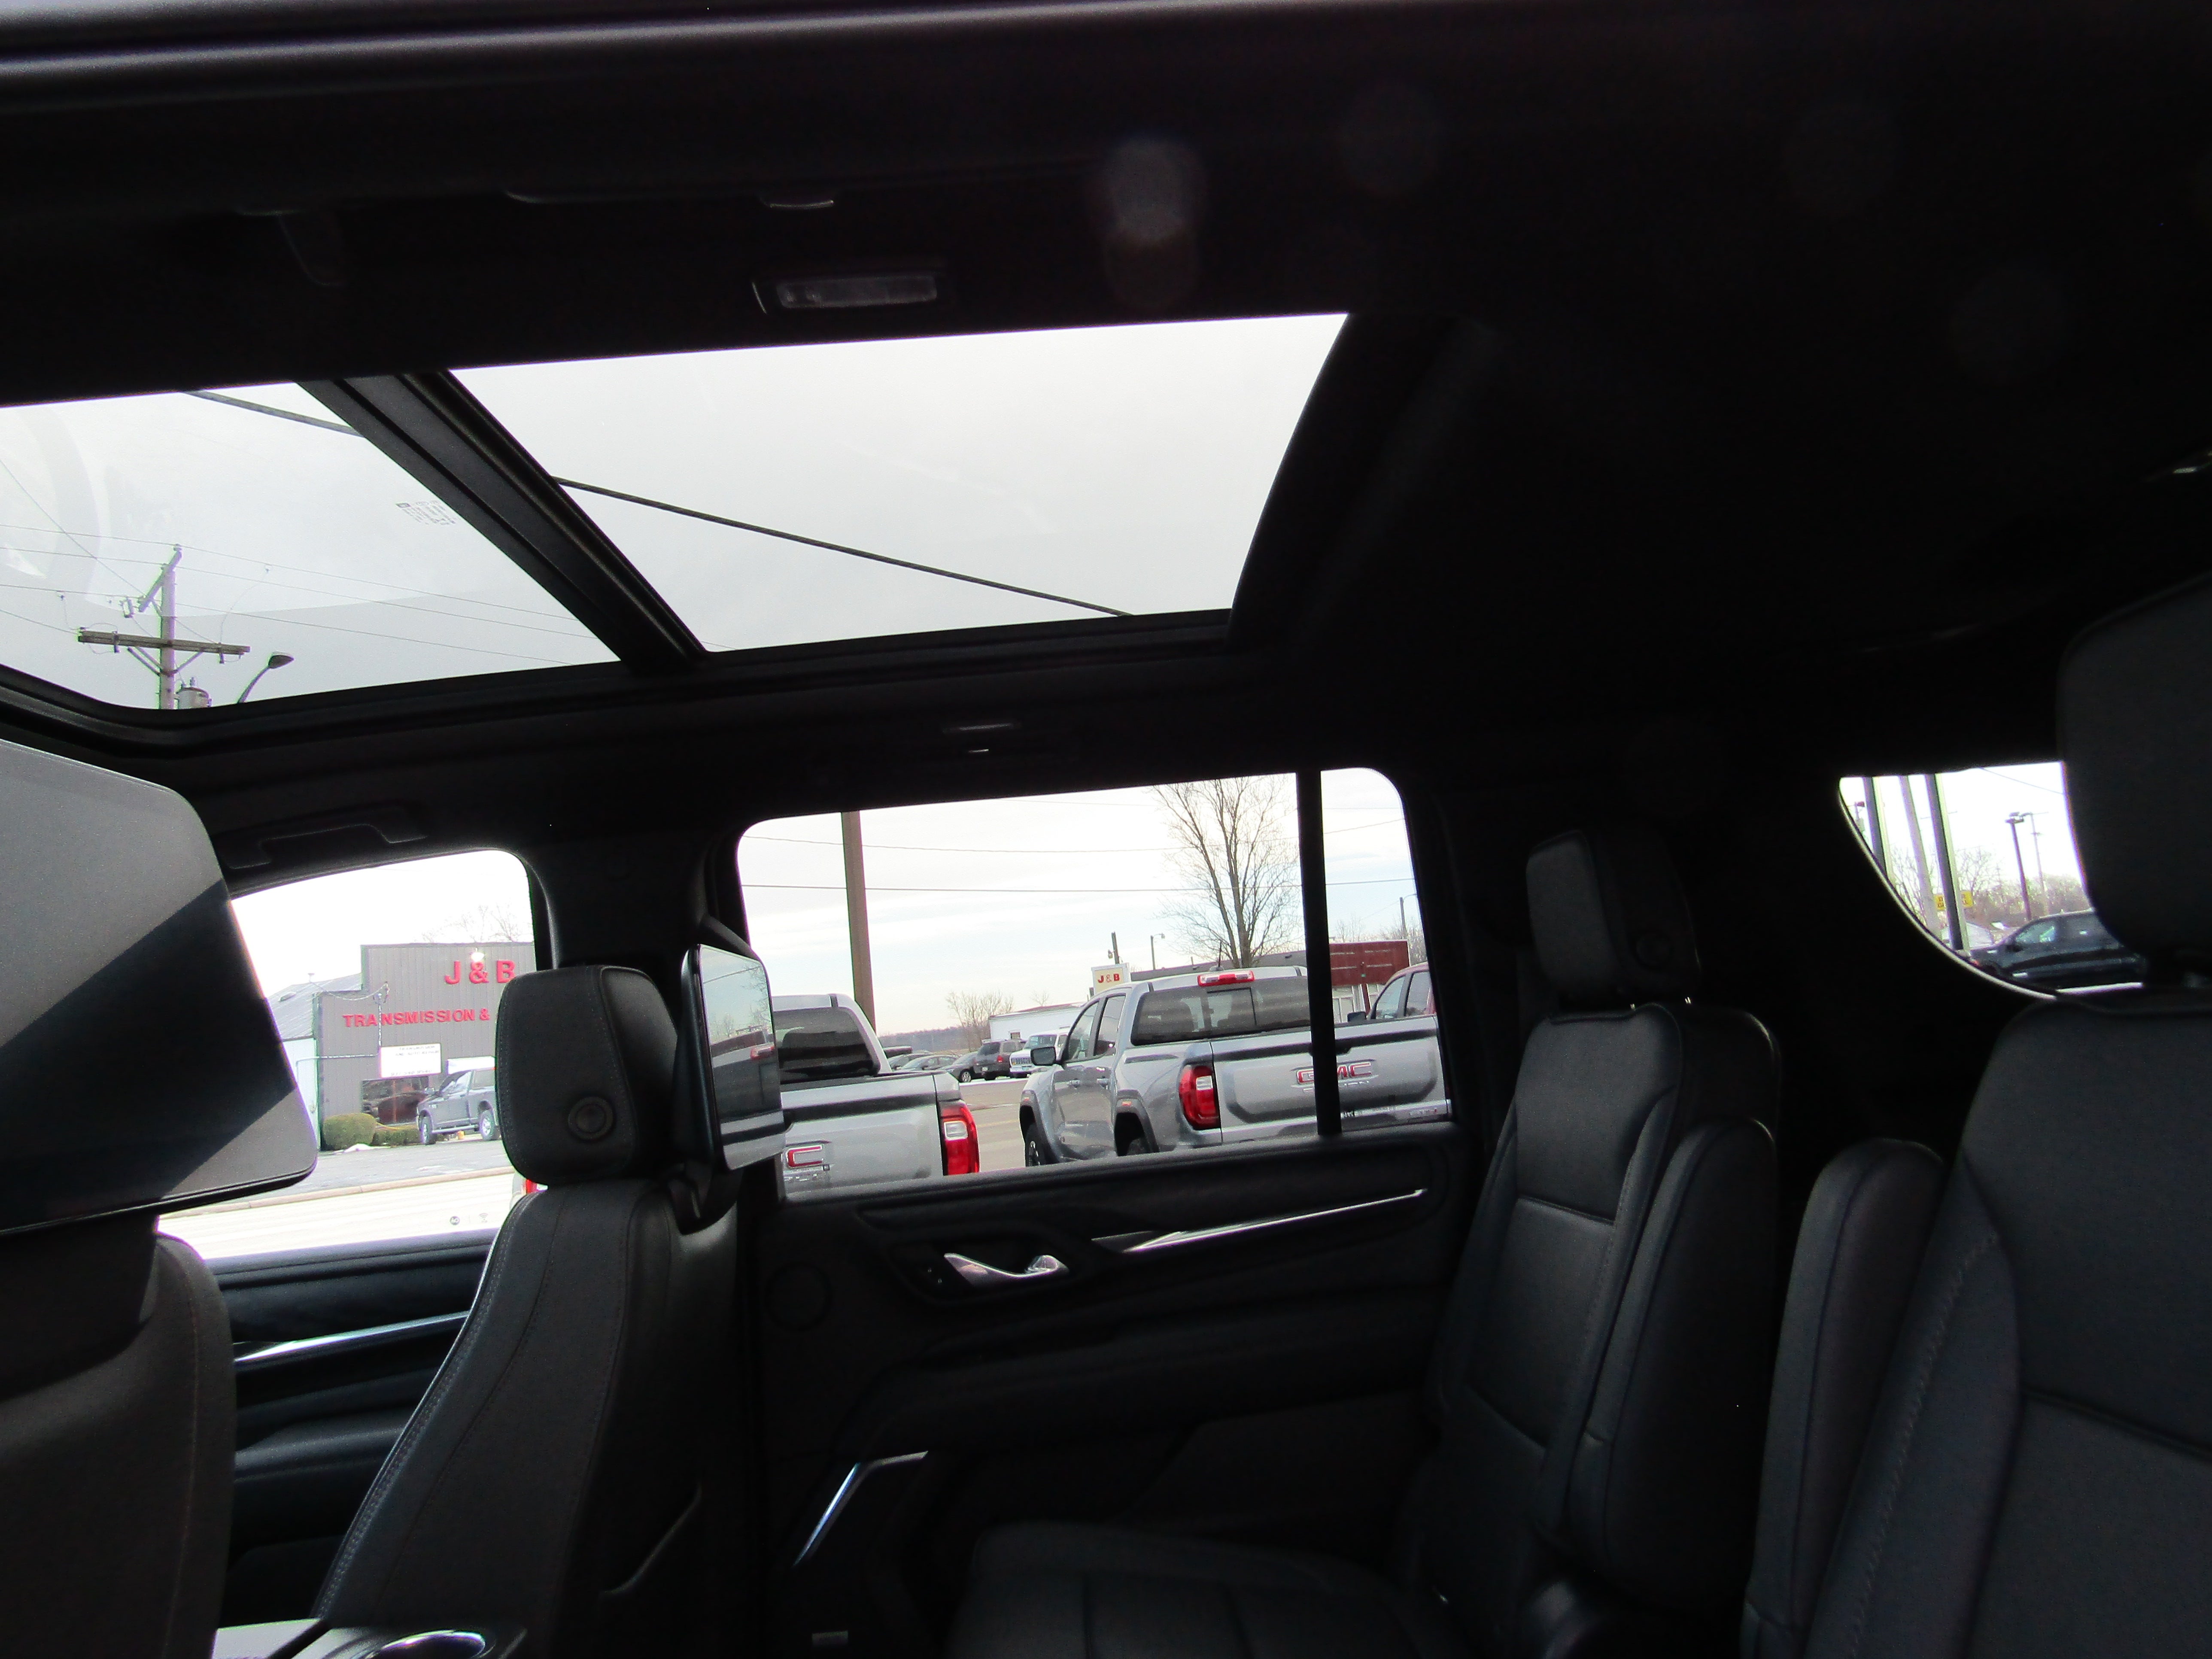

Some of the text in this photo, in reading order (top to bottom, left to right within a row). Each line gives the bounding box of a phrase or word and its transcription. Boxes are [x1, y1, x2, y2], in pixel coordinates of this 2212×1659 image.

[444, 960, 515, 984] J & B
[1097, 975, 1104, 983] J
[1106, 974, 1112, 983] &
[343, 1008, 490, 1027] TRANSMISSION &
